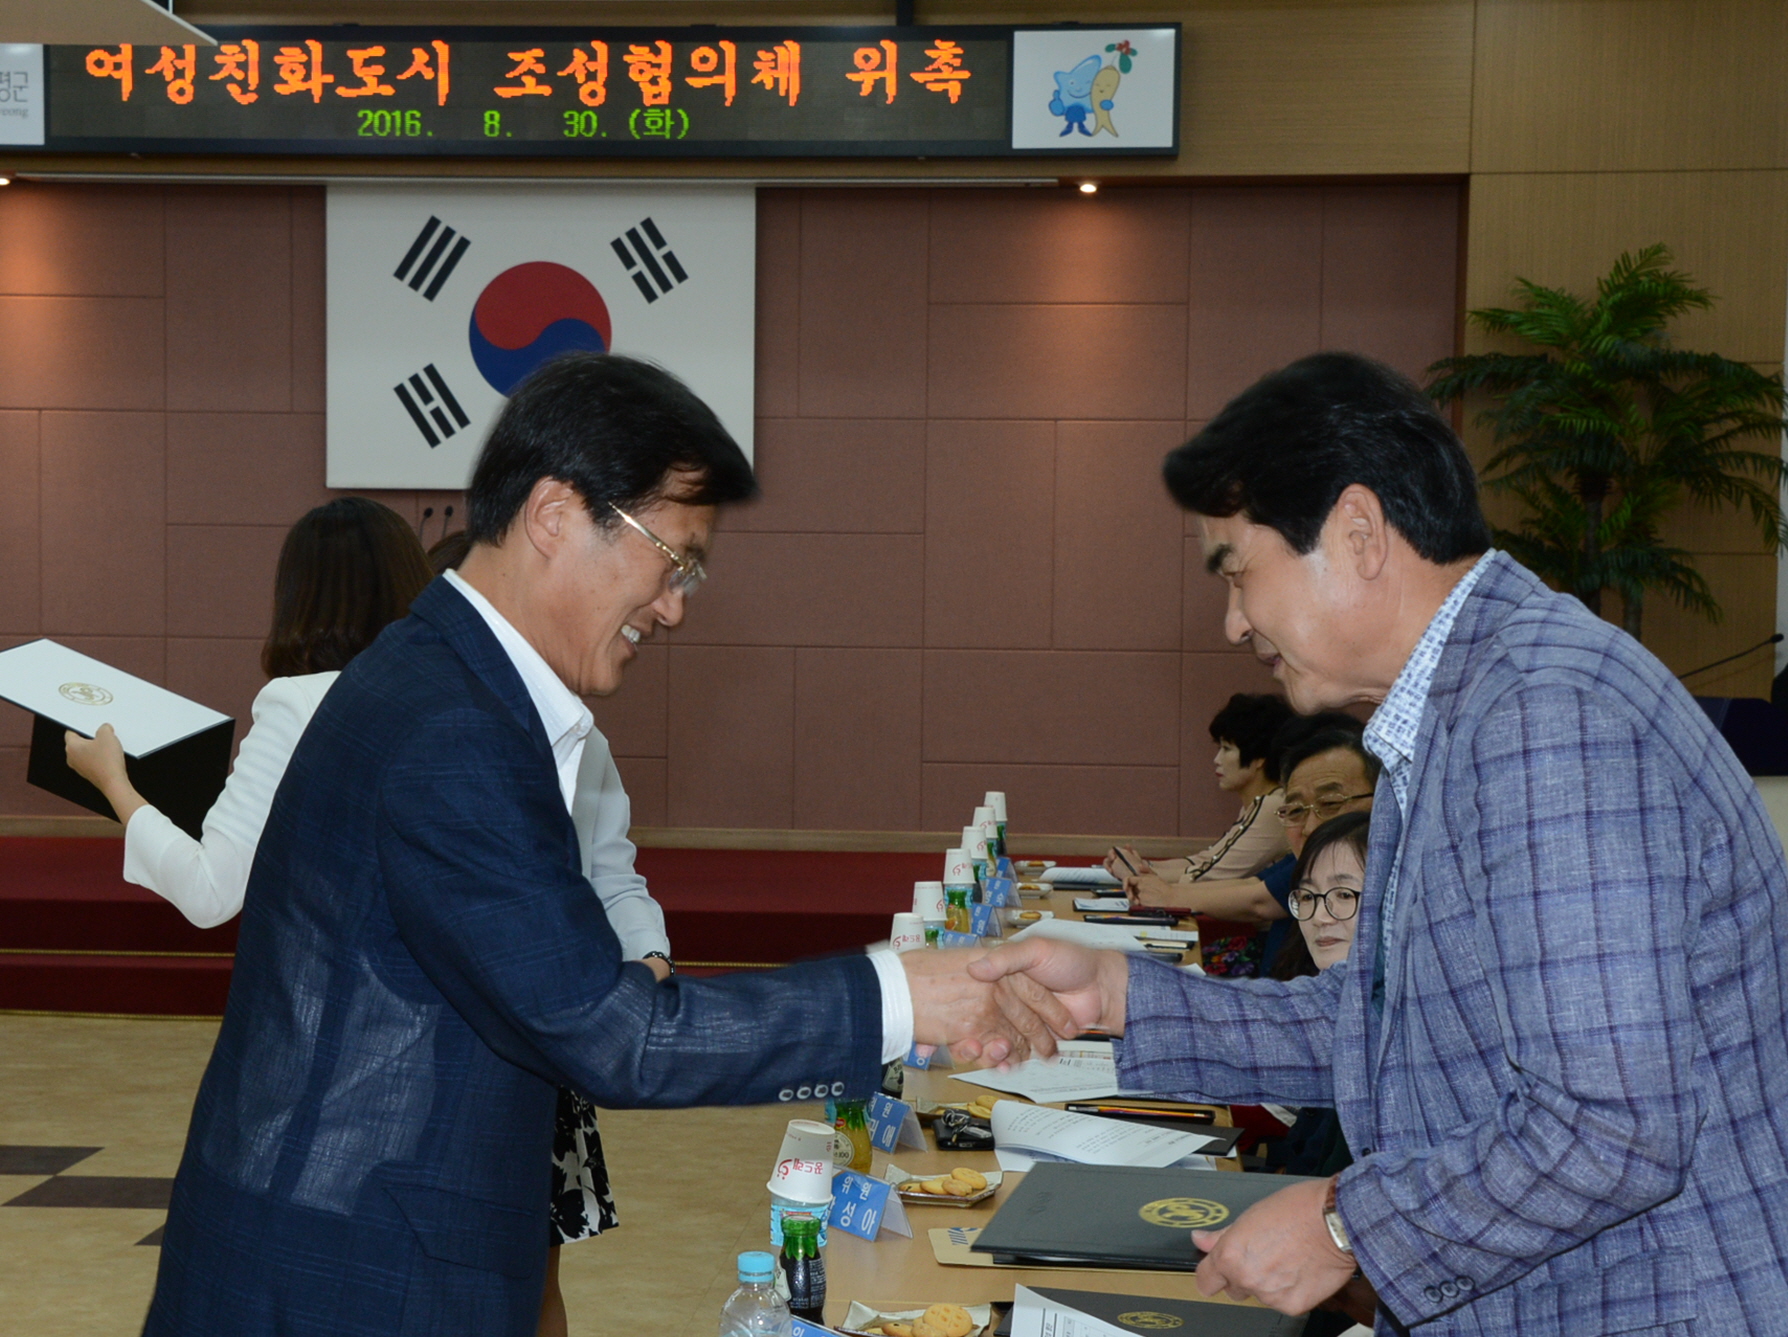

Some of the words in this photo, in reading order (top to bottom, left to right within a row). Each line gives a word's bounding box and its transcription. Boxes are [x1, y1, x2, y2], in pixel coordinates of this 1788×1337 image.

[86, 39, 450, 105] 여성친화도시
[494, 40, 801, 107] 조성협의체
[846, 39, 971, 105] 위촉
[357, 109, 433, 137] 2016.
[483, 109, 512, 137] 8.
[563, 110, 607, 138] 30.
[628, 108, 690, 140] (화)
